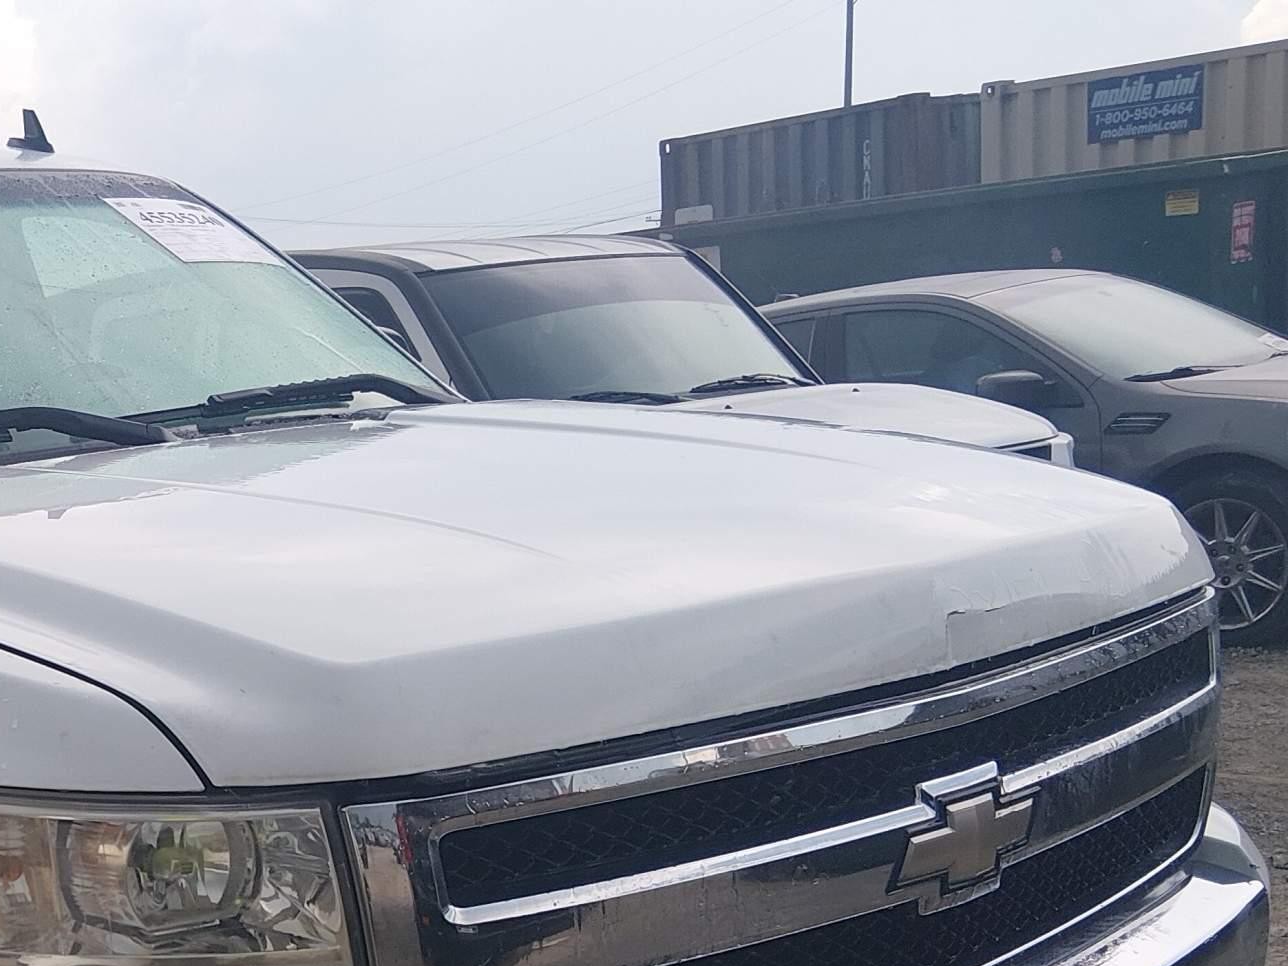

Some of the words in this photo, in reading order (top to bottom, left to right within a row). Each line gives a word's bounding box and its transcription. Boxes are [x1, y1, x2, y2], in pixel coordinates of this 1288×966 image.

[1091, 75, 1153, 108] mobile
[1154, 71, 1199, 99] mini
[1095, 101, 1194, 126] 1-800-950-6464
[1100, 119, 1188, 139] mobilemini.com
